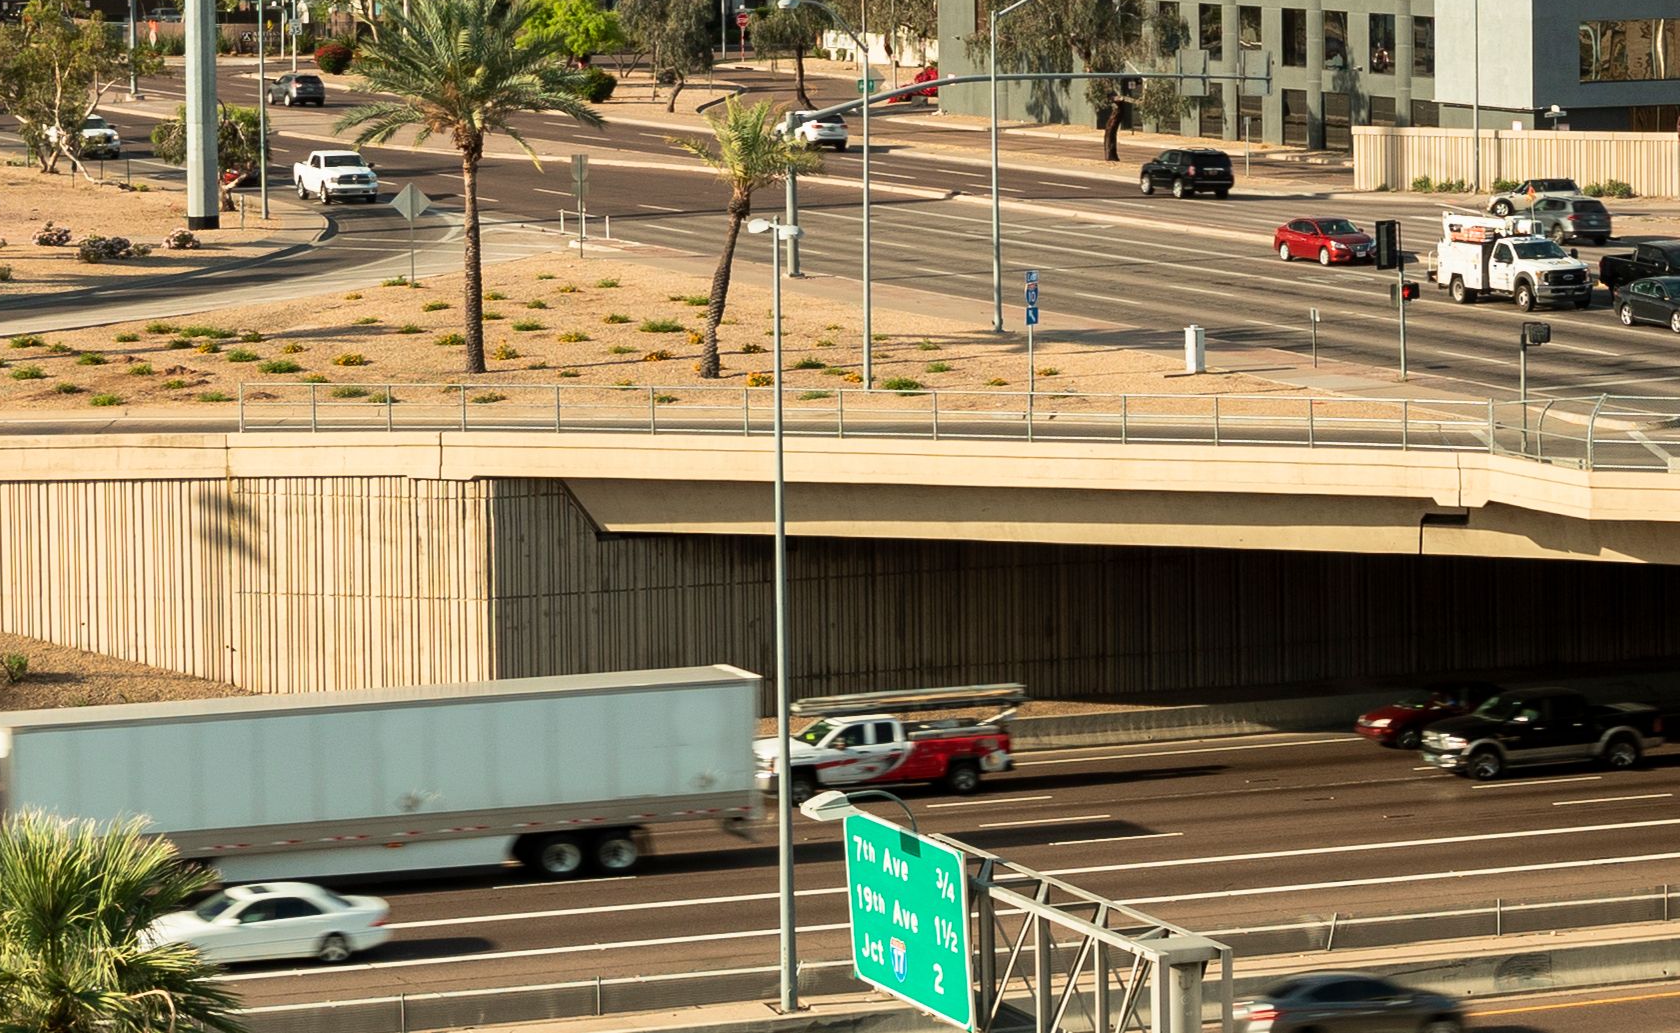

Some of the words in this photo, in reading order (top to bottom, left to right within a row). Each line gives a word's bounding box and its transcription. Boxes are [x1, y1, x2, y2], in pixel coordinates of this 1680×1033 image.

[853, 835, 876, 864] 7th
[883, 848, 908, 882] Ave
[856, 883, 886, 915] 19th
[893, 900, 918, 934] Ave
[862, 932, 885, 966] Jct
[893, 949, 905, 975] 17
[932, 963, 945, 995] 2
